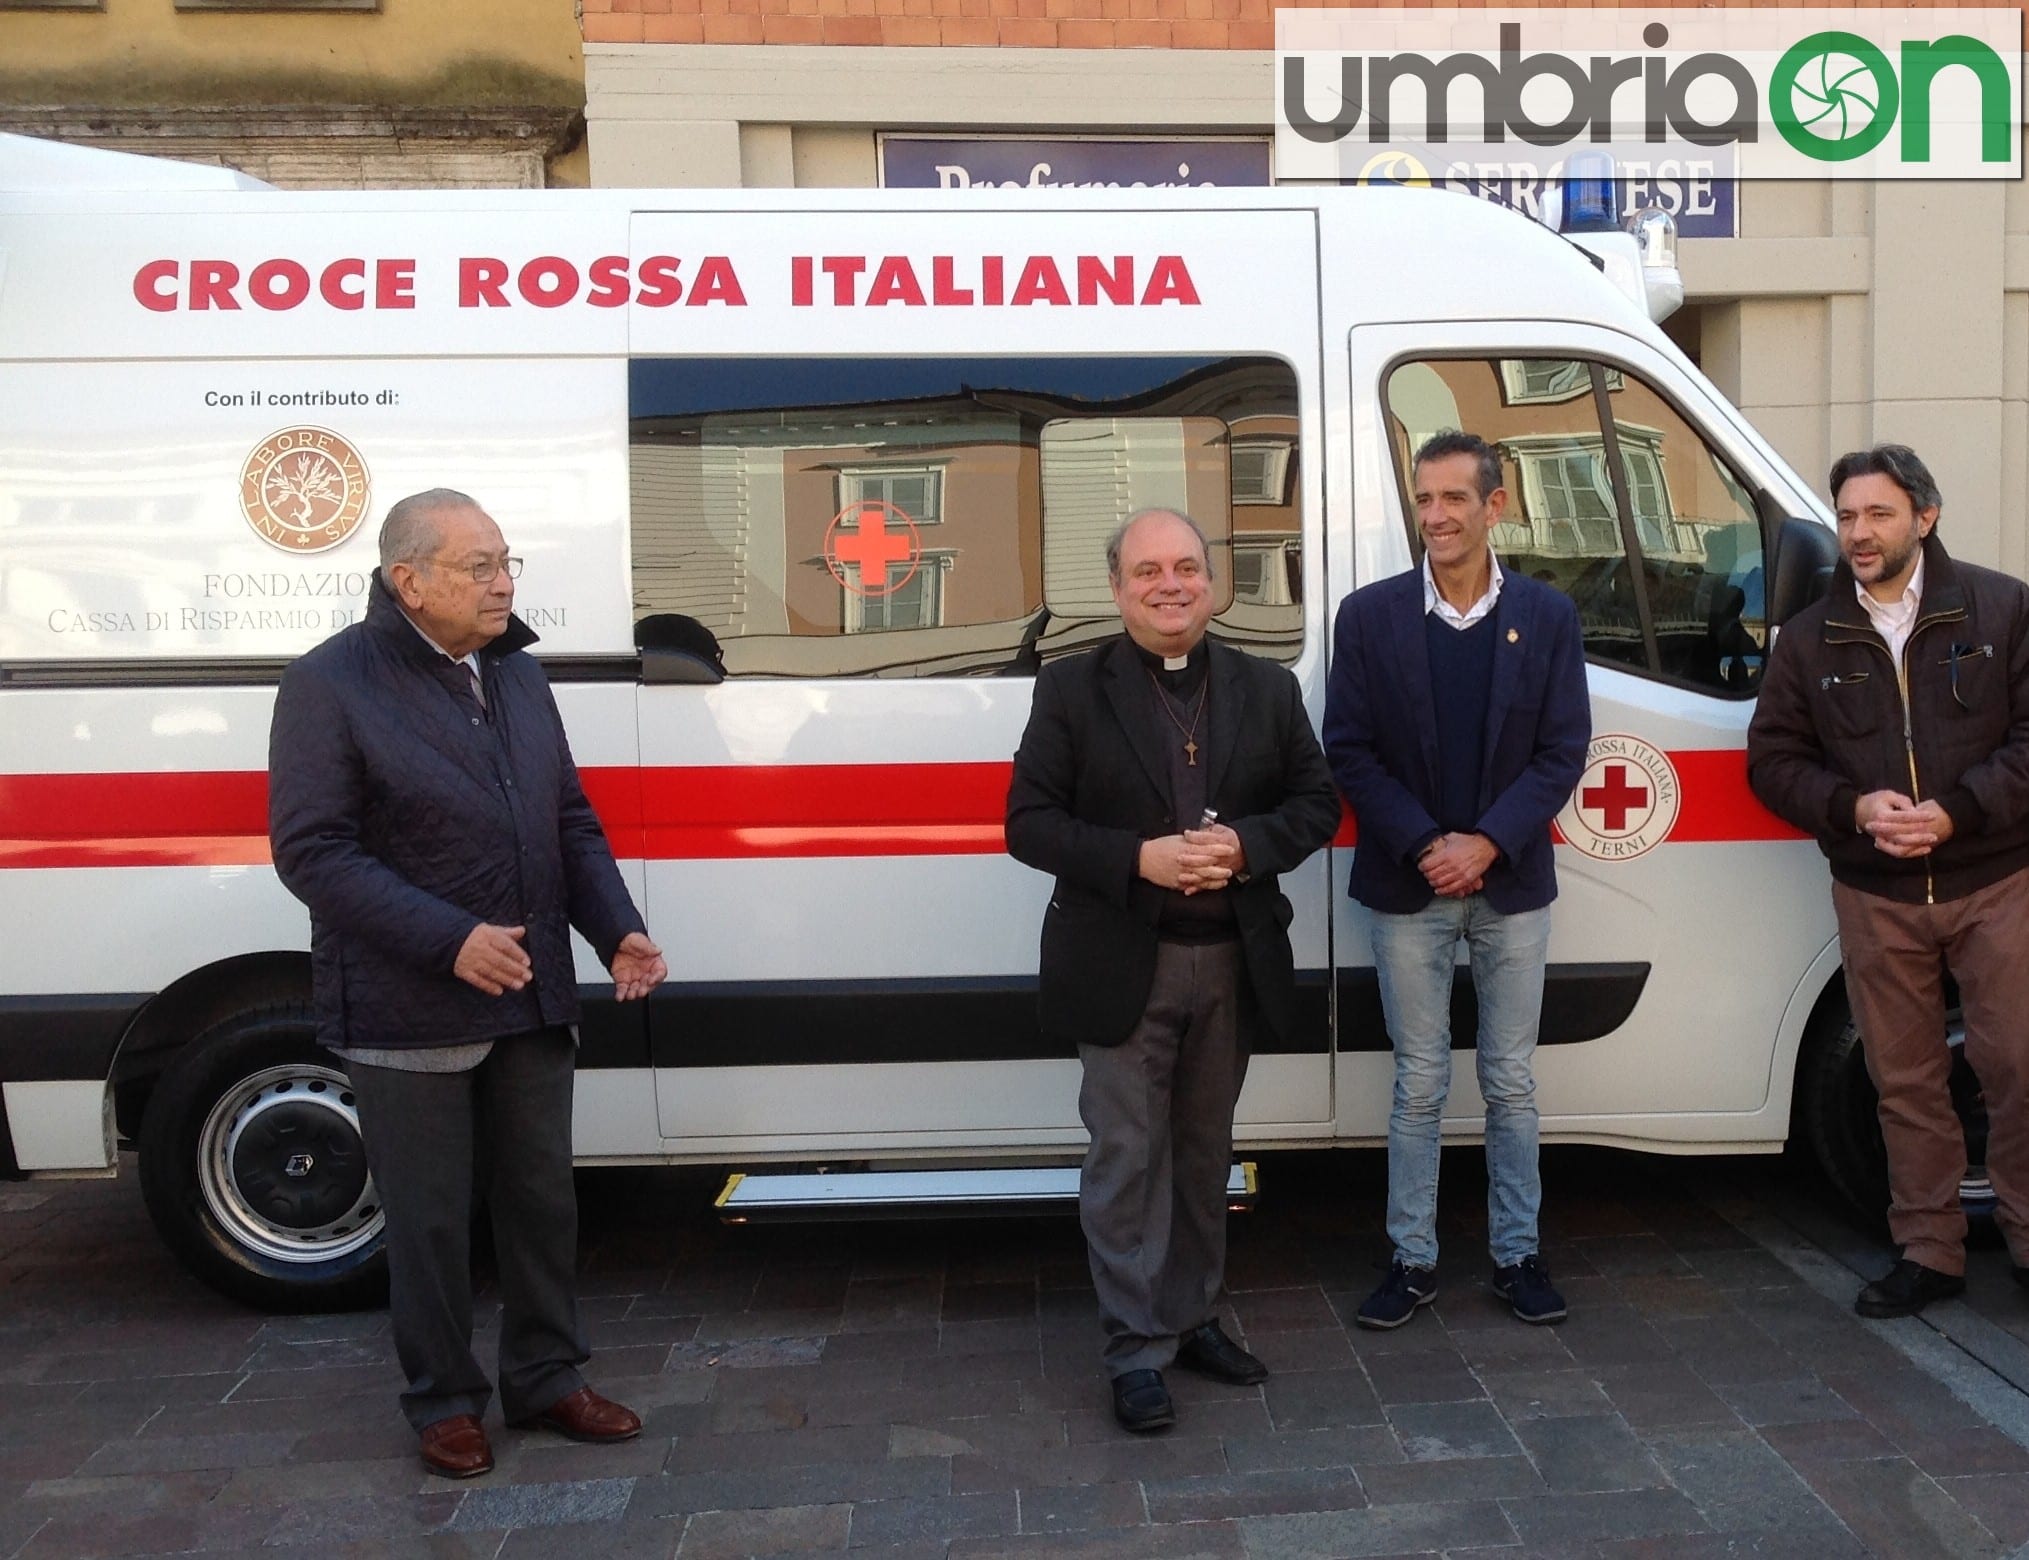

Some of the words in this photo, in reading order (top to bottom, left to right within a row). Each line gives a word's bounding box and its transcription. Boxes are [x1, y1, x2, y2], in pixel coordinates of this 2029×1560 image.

[132, 258, 416, 312] CROCE
[458, 255, 748, 308] ROSSA
[791, 255, 1202, 306] ITALIANA
[204, 391, 244, 407] Con
[251, 391, 262, 406] il
[267, 390, 370, 406] contributo
[376, 390, 401, 406] di:
[246, 431, 334, 508] LABORE
[325, 451, 365, 541] VIRTVS
[256, 515, 287, 543] IN
[1632, 745, 1673, 801] ITALIANA
[1590, 835, 1648, 857] TERNI
